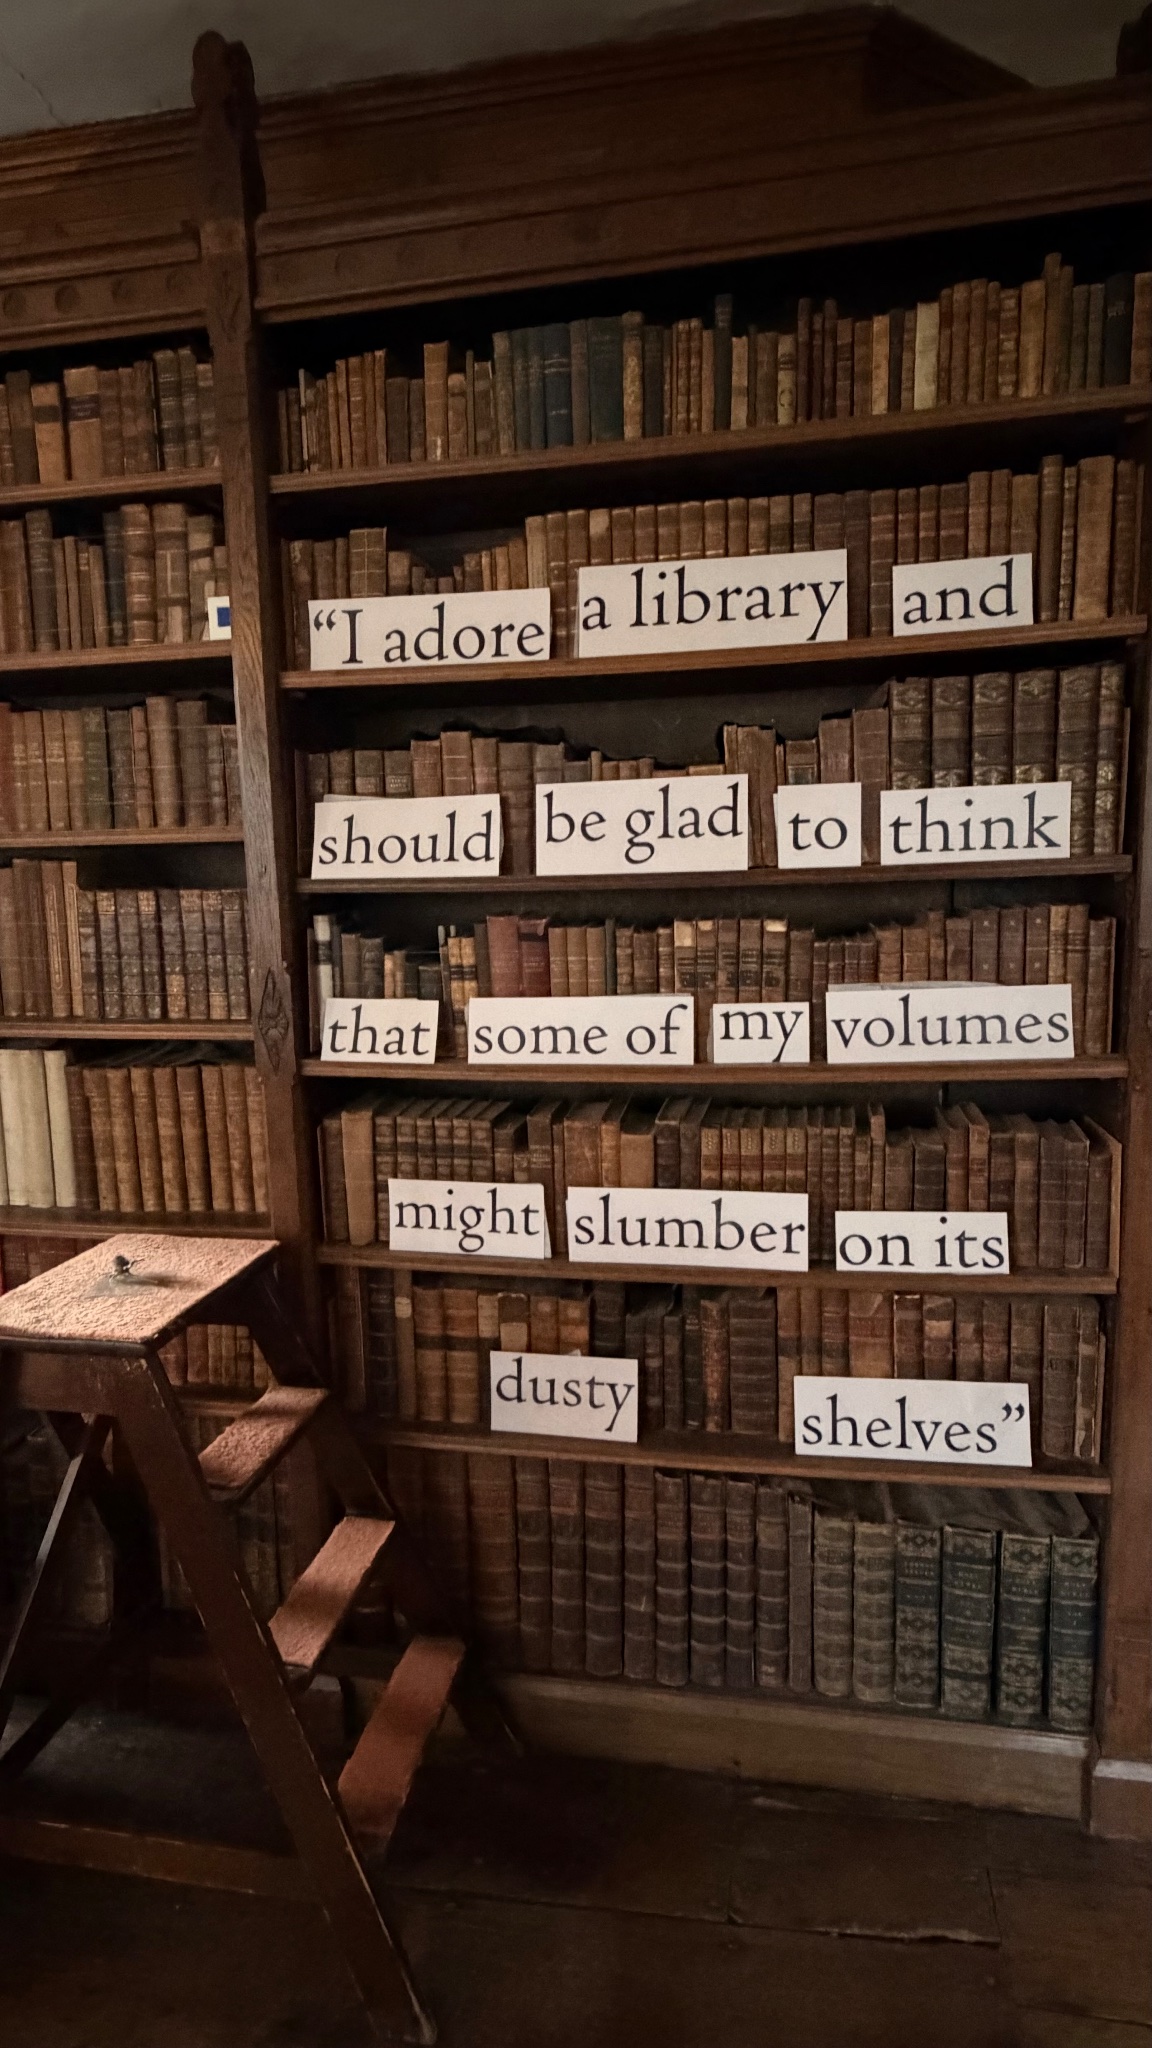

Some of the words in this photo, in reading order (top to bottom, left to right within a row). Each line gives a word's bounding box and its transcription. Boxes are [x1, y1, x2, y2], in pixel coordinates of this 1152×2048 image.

[582, 596, 612, 632] a
[629, 565, 845, 642] library
[902, 557, 1019, 625] and
[313, 609, 364, 665] “I
[384, 601, 545, 663] adore
[318, 809, 495, 865] should
[543, 790, 606, 843] be
[624, 781, 743, 865] glad
[788, 813, 848, 851] to
[889, 790, 1061, 855] think
[328, 1004, 431, 1056] that
[474, 1025, 608, 1055] some
[626, 1003, 688, 1055] of
[719, 1010, 804, 1063] my
[831, 993, 1070, 1049] volumes
[395, 1187, 540, 1254] might
[574, 1193, 806, 1254] slumber
[839, 1234, 915, 1267] on
[934, 1216, 1005, 1269] its
[495, 1355, 635, 1433] dusty
[802, 1393, 1025, 1454] shelves”
